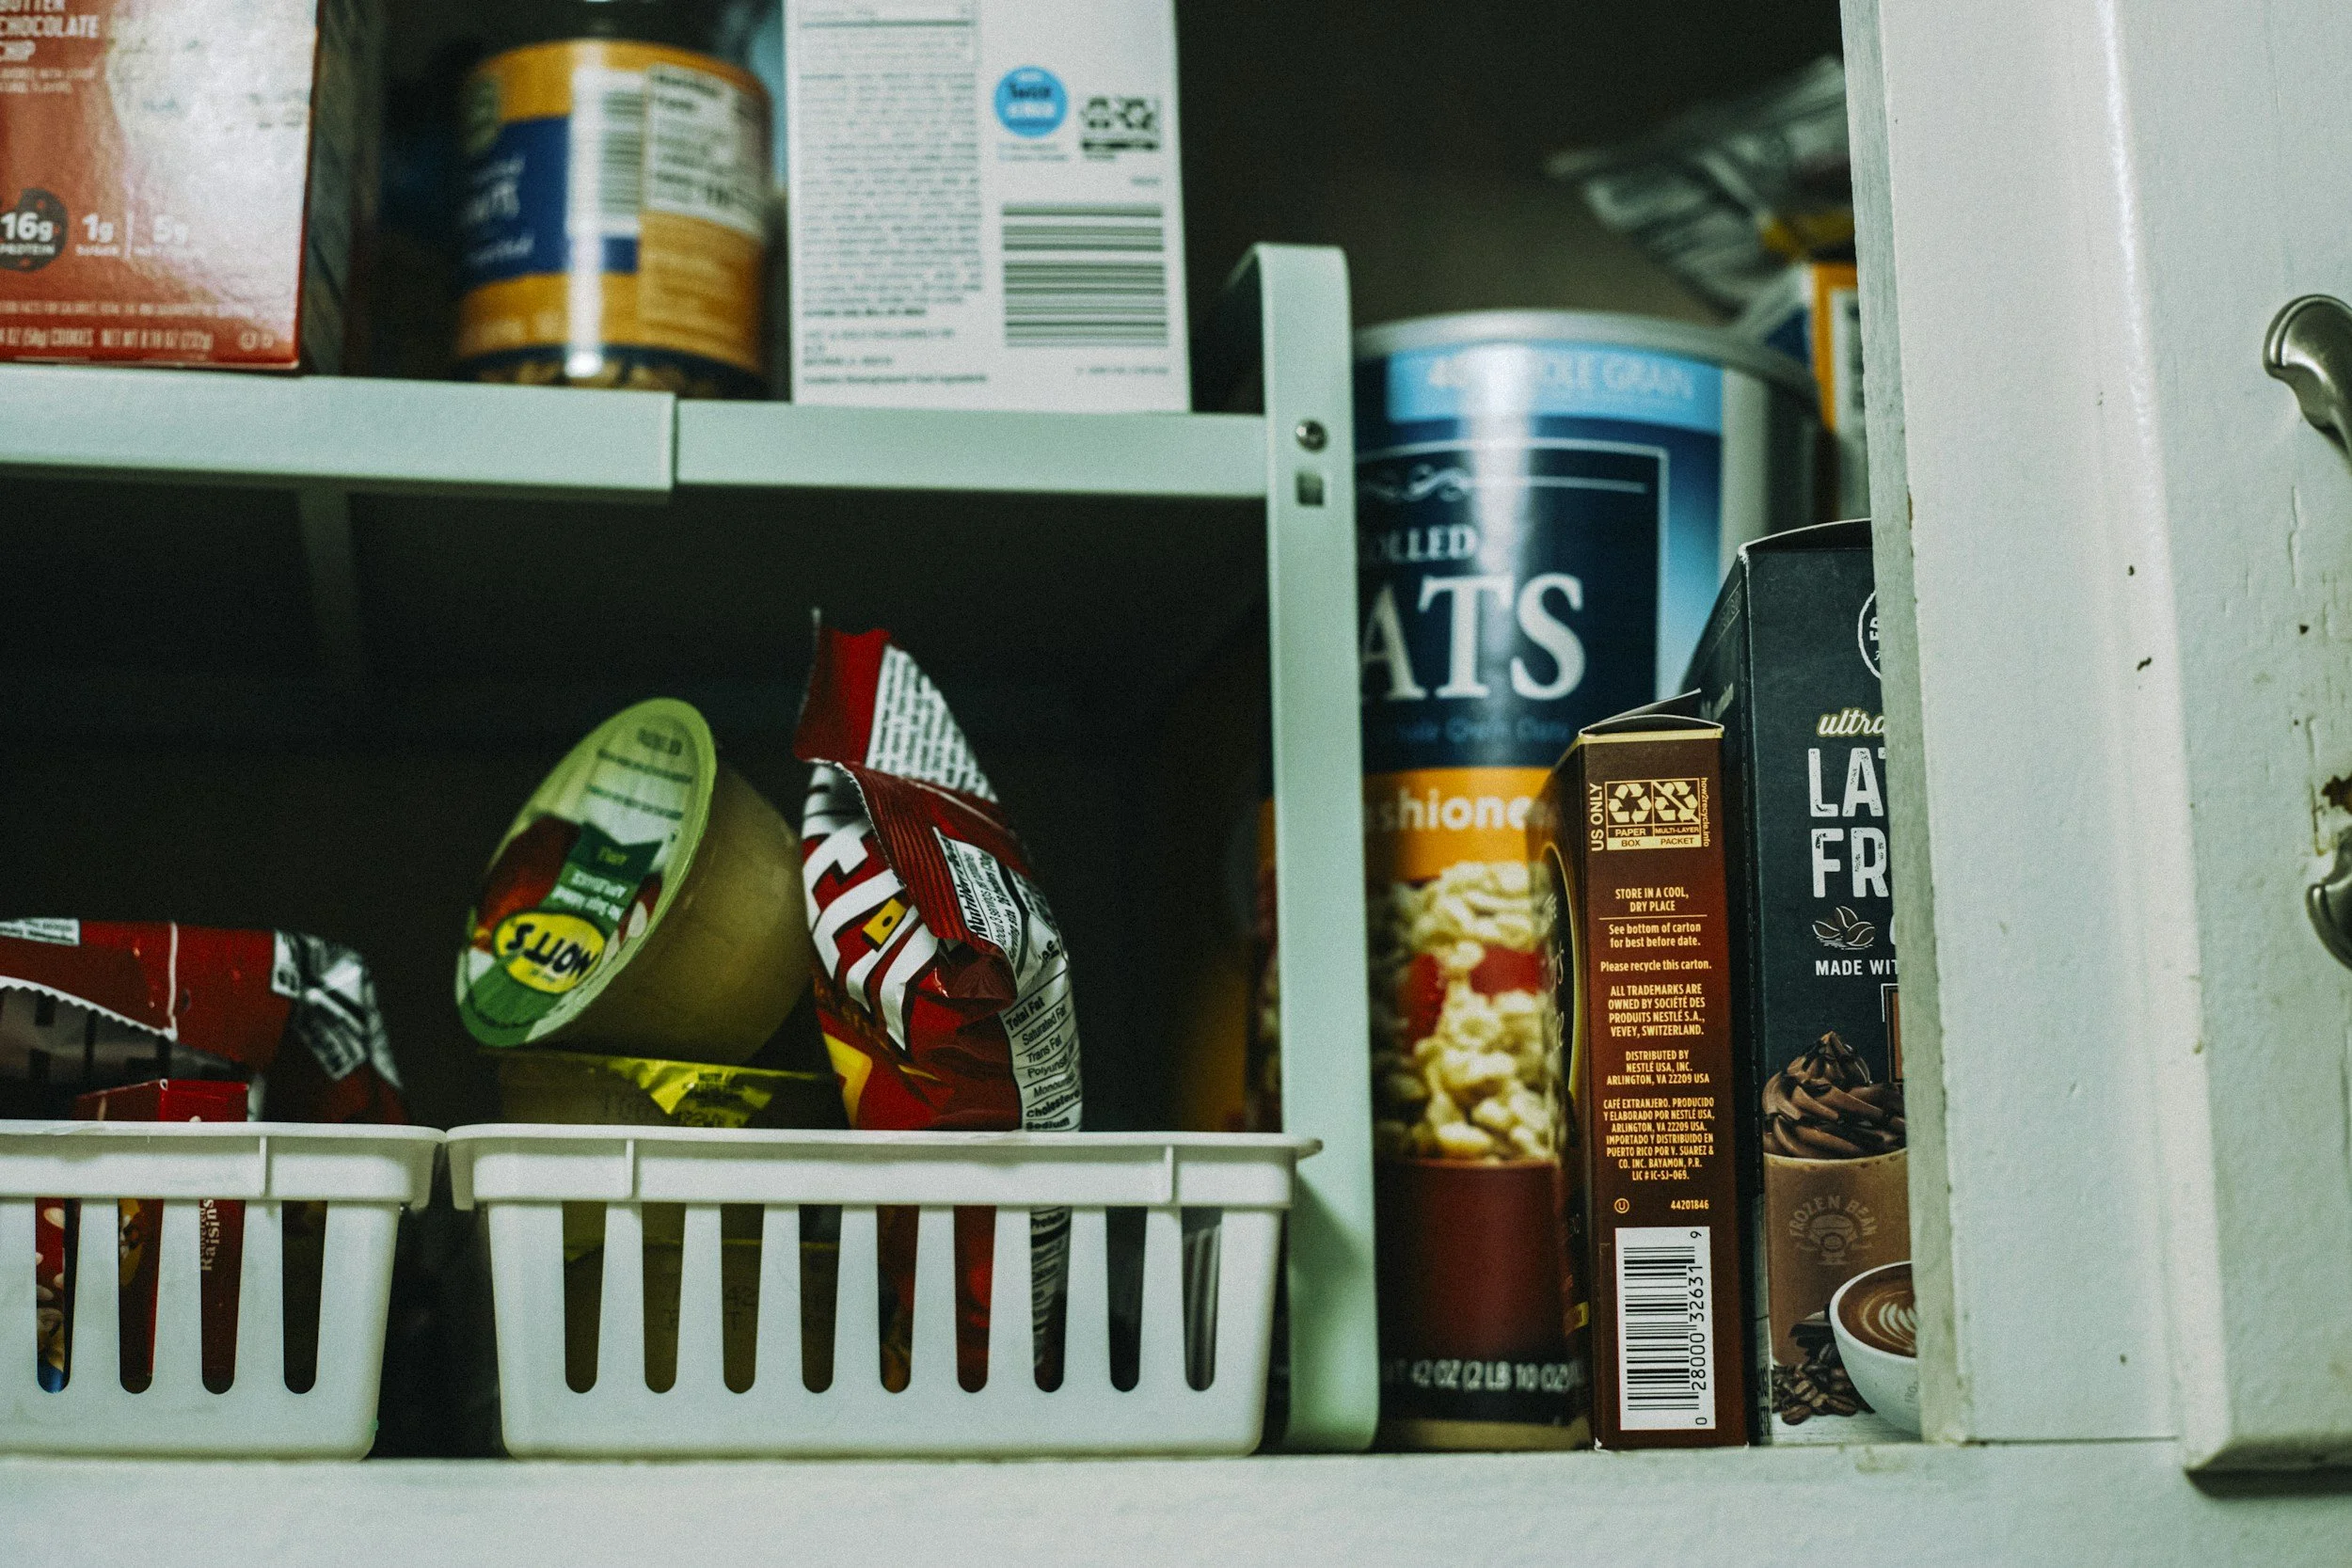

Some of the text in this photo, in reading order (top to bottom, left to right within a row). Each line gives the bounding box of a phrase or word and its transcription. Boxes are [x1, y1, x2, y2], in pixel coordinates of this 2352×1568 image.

[1, 212, 54, 242] 16g
[82, 213, 114, 244] 1g
[1808, 747, 1886, 816] LA
[1589, 783, 1604, 851] US ONLY
[1615, 828, 1646, 836] PAPER
[1661, 837, 1693, 846] PACKET
[1615, 887, 1690, 899] STORE IN A COOL,
[980, 889, 1001, 917] servings
[1629, 900, 1676, 912] DRY PLACE
[1004, 908, 1017, 925] size
[995, 921, 1006, 947] About
[1609, 923, 1701, 935] See bottom of carton
[1007, 924, 1019, 962] Serving
[1610, 936, 1701, 948] for best before date.
[1600, 958, 1711, 973] Please recycle this carton.
[1815, 959, 1863, 975] MADE
[1610, 983, 1702, 996] ALL TRADEMARKS ARE
[1608, 995, 1706, 1010] OWNED BY SOCIÉTÉ DES
[1006, 996, 1045, 1031] Total Fat
[1609, 1009, 1705, 1023] PRODUITS NESTLÉ S.A.,
[1022, 1011, 1056, 1046] Saturated
[1610, 1023, 1704, 1038] VEVEY, SWITZERLAND.
[1025, 1043, 1050, 1065] Trans
[1626, 1050, 1690, 1061] DISTRIBUTED BY
[1626, 1061, 1692, 1074] NESTLÉ USA, INC.
[1607, 1073, 1710, 1086] ARLINGTON, VA 22209 USA
[1603, 1097, 1714, 1110] CAFÉ EXTRANJERO. PRODUCIDO
[1603, 1111, 1609, 1121] Y
[1610, 1110, 1653, 1121] ELABORADO
[1654, 1110, 1670, 1120] POR
[1671, 1107, 1696, 1120] NESTLÉ
[1612, 1121, 1708, 1133] ARLINGTON, VA 22209 USA.
[1606, 1133, 1714, 1145] IMPORTADO Y DISTRIBUIDO EN
[1606, 1146, 1714, 1157] PUERTO RICO POR V. SUAREZ &
[1618, 1157, 1703, 1170] CO. INC. BAYAMON, P.R.
[1631, 1171, 1644, 1180] LIC
[1671, 1199, 1709, 1210] 44201846
[1688, 1230, 1708, 1425] 0 28000 32631 9
